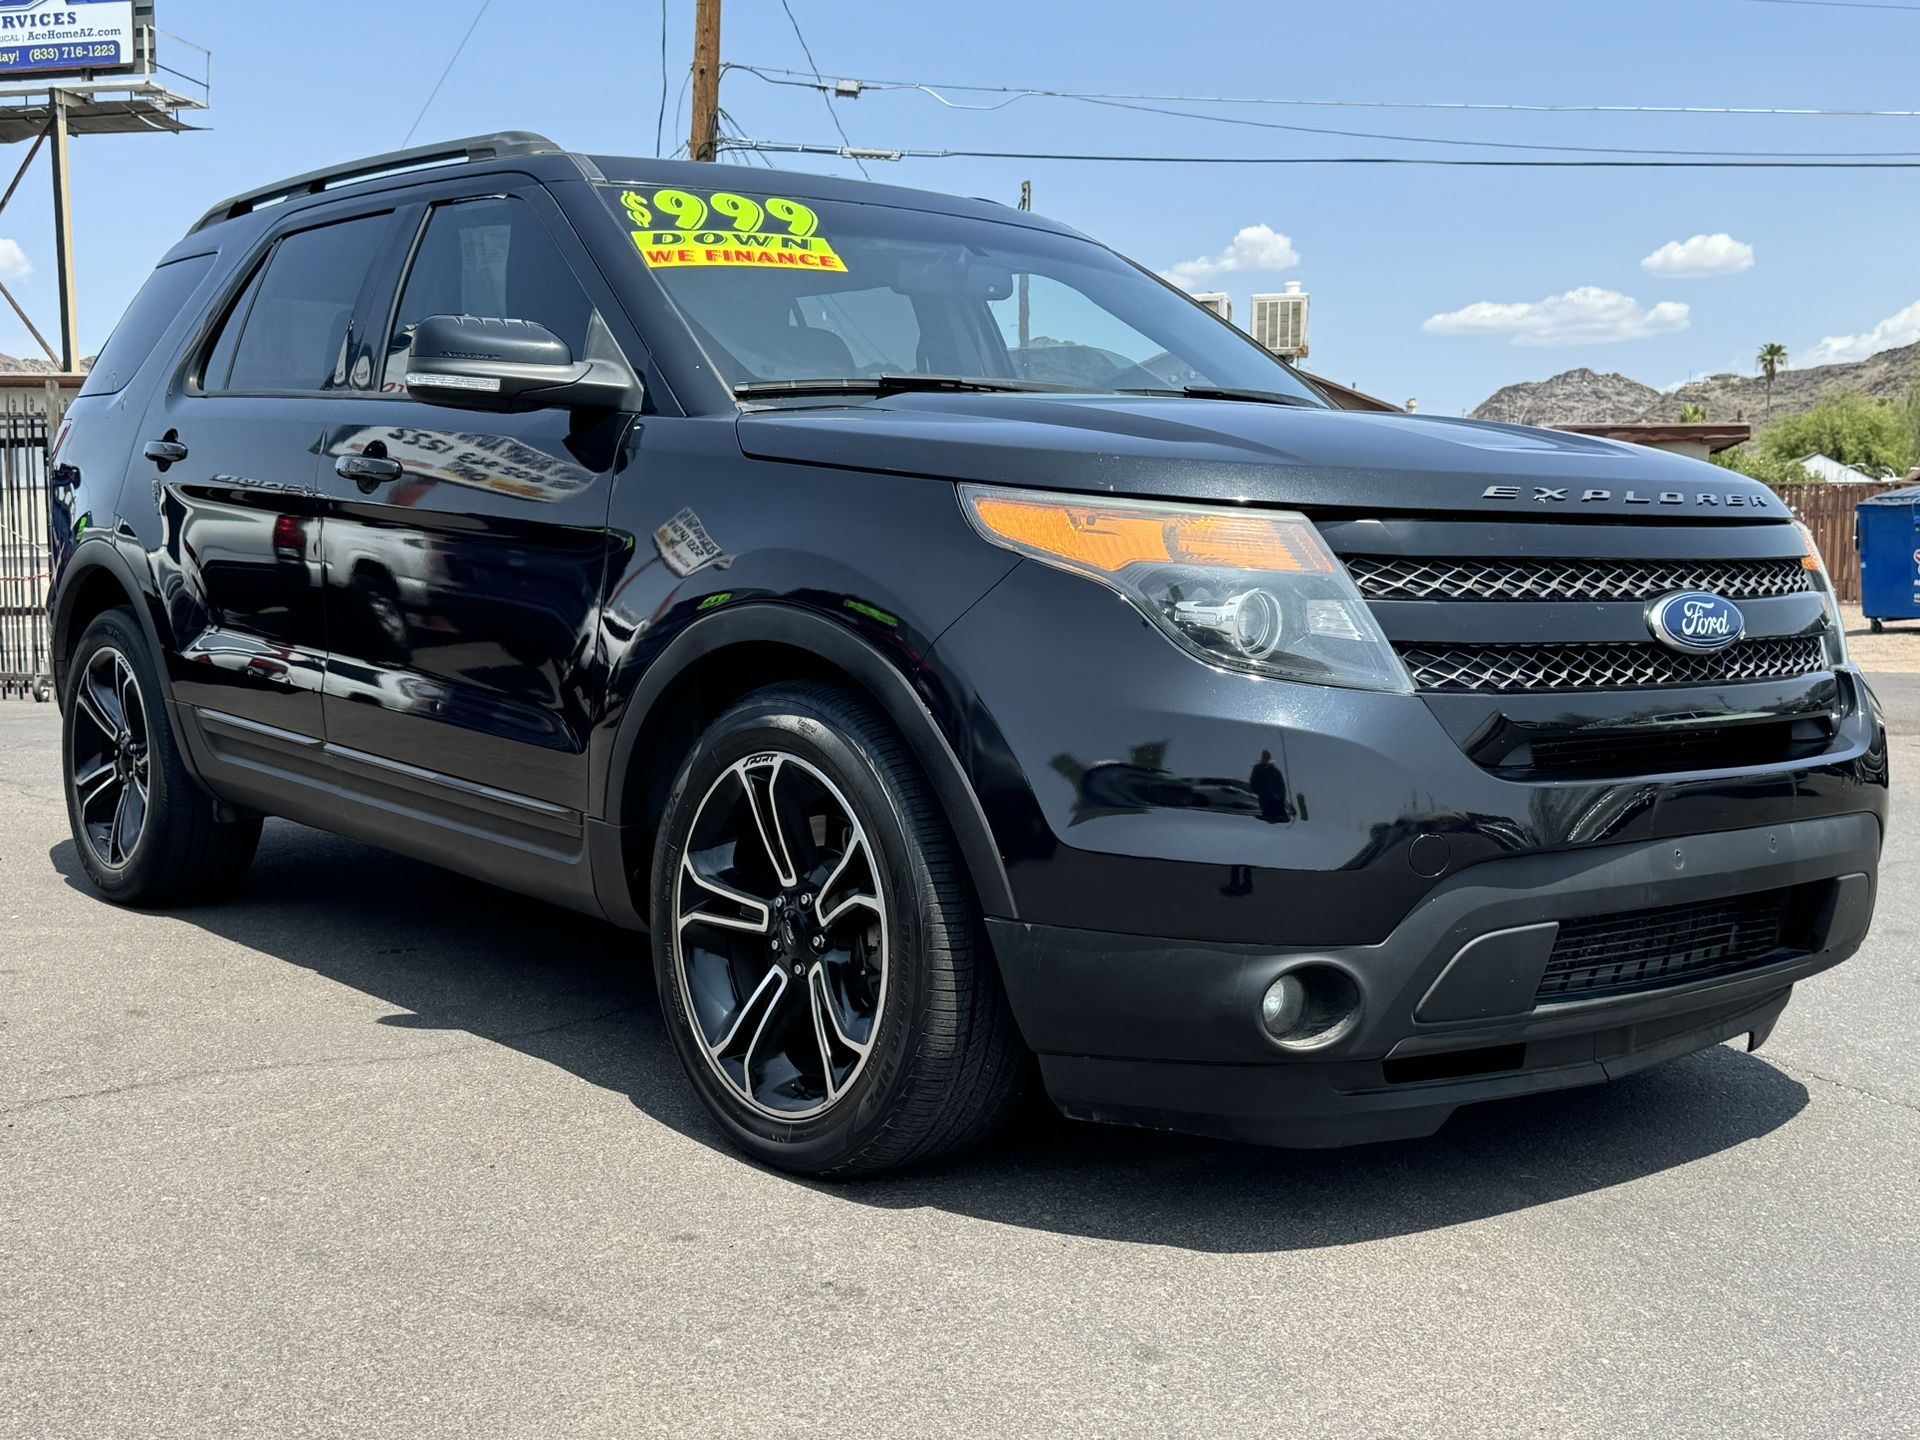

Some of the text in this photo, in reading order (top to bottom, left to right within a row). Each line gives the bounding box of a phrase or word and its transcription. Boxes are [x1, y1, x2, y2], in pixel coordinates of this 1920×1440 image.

[27, 28, 121, 41] AceHomeAZ.com
[0, 44, 116, 64] ay! (833) 716-1223
[620, 189, 819, 237] $999
[652, 232, 813, 251] DOWN
[646, 250, 838, 268] WE FINANCE
[1481, 484, 1770, 508] EXPLORER
[1681, 600, 1730, 636] Ford
[742, 753, 778, 768] SPORT
